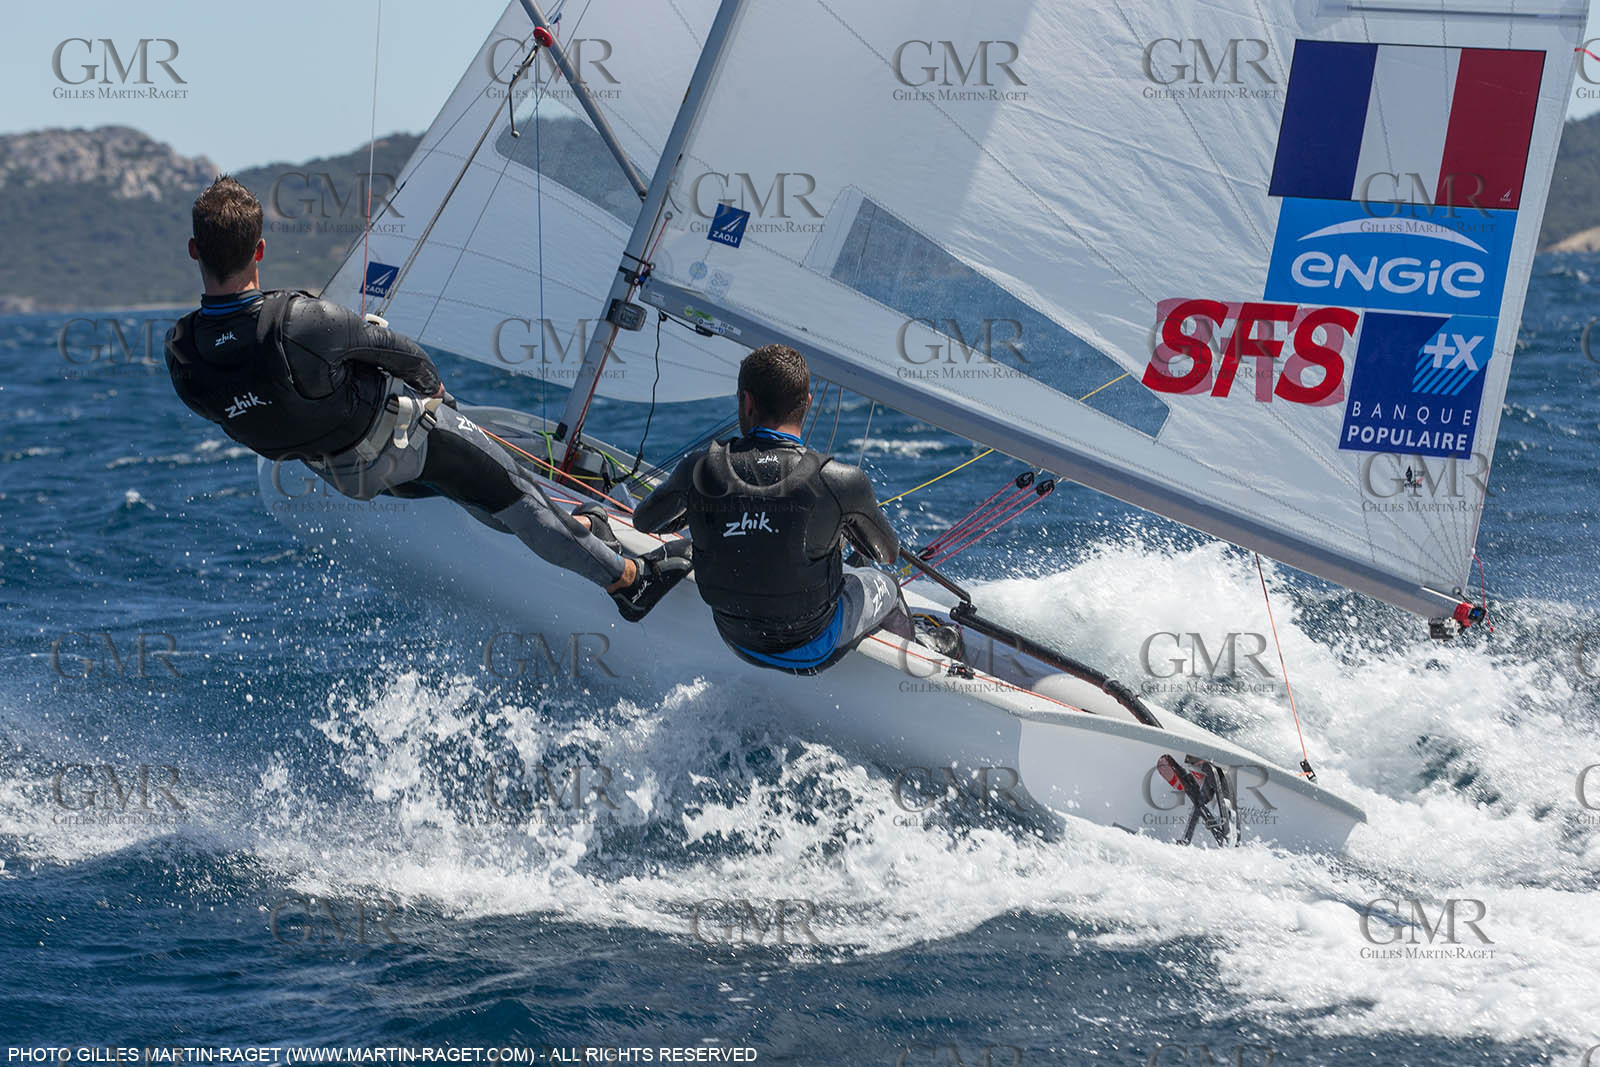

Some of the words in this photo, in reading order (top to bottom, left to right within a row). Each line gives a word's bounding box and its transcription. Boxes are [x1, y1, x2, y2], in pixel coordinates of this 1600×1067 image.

[712, 231, 738, 243] ZAOLI
[1142, 299, 1359, 404] SFS
[1352, 401, 1472, 426] BANQUE
[1347, 425, 1468, 451] POPULAIRE
